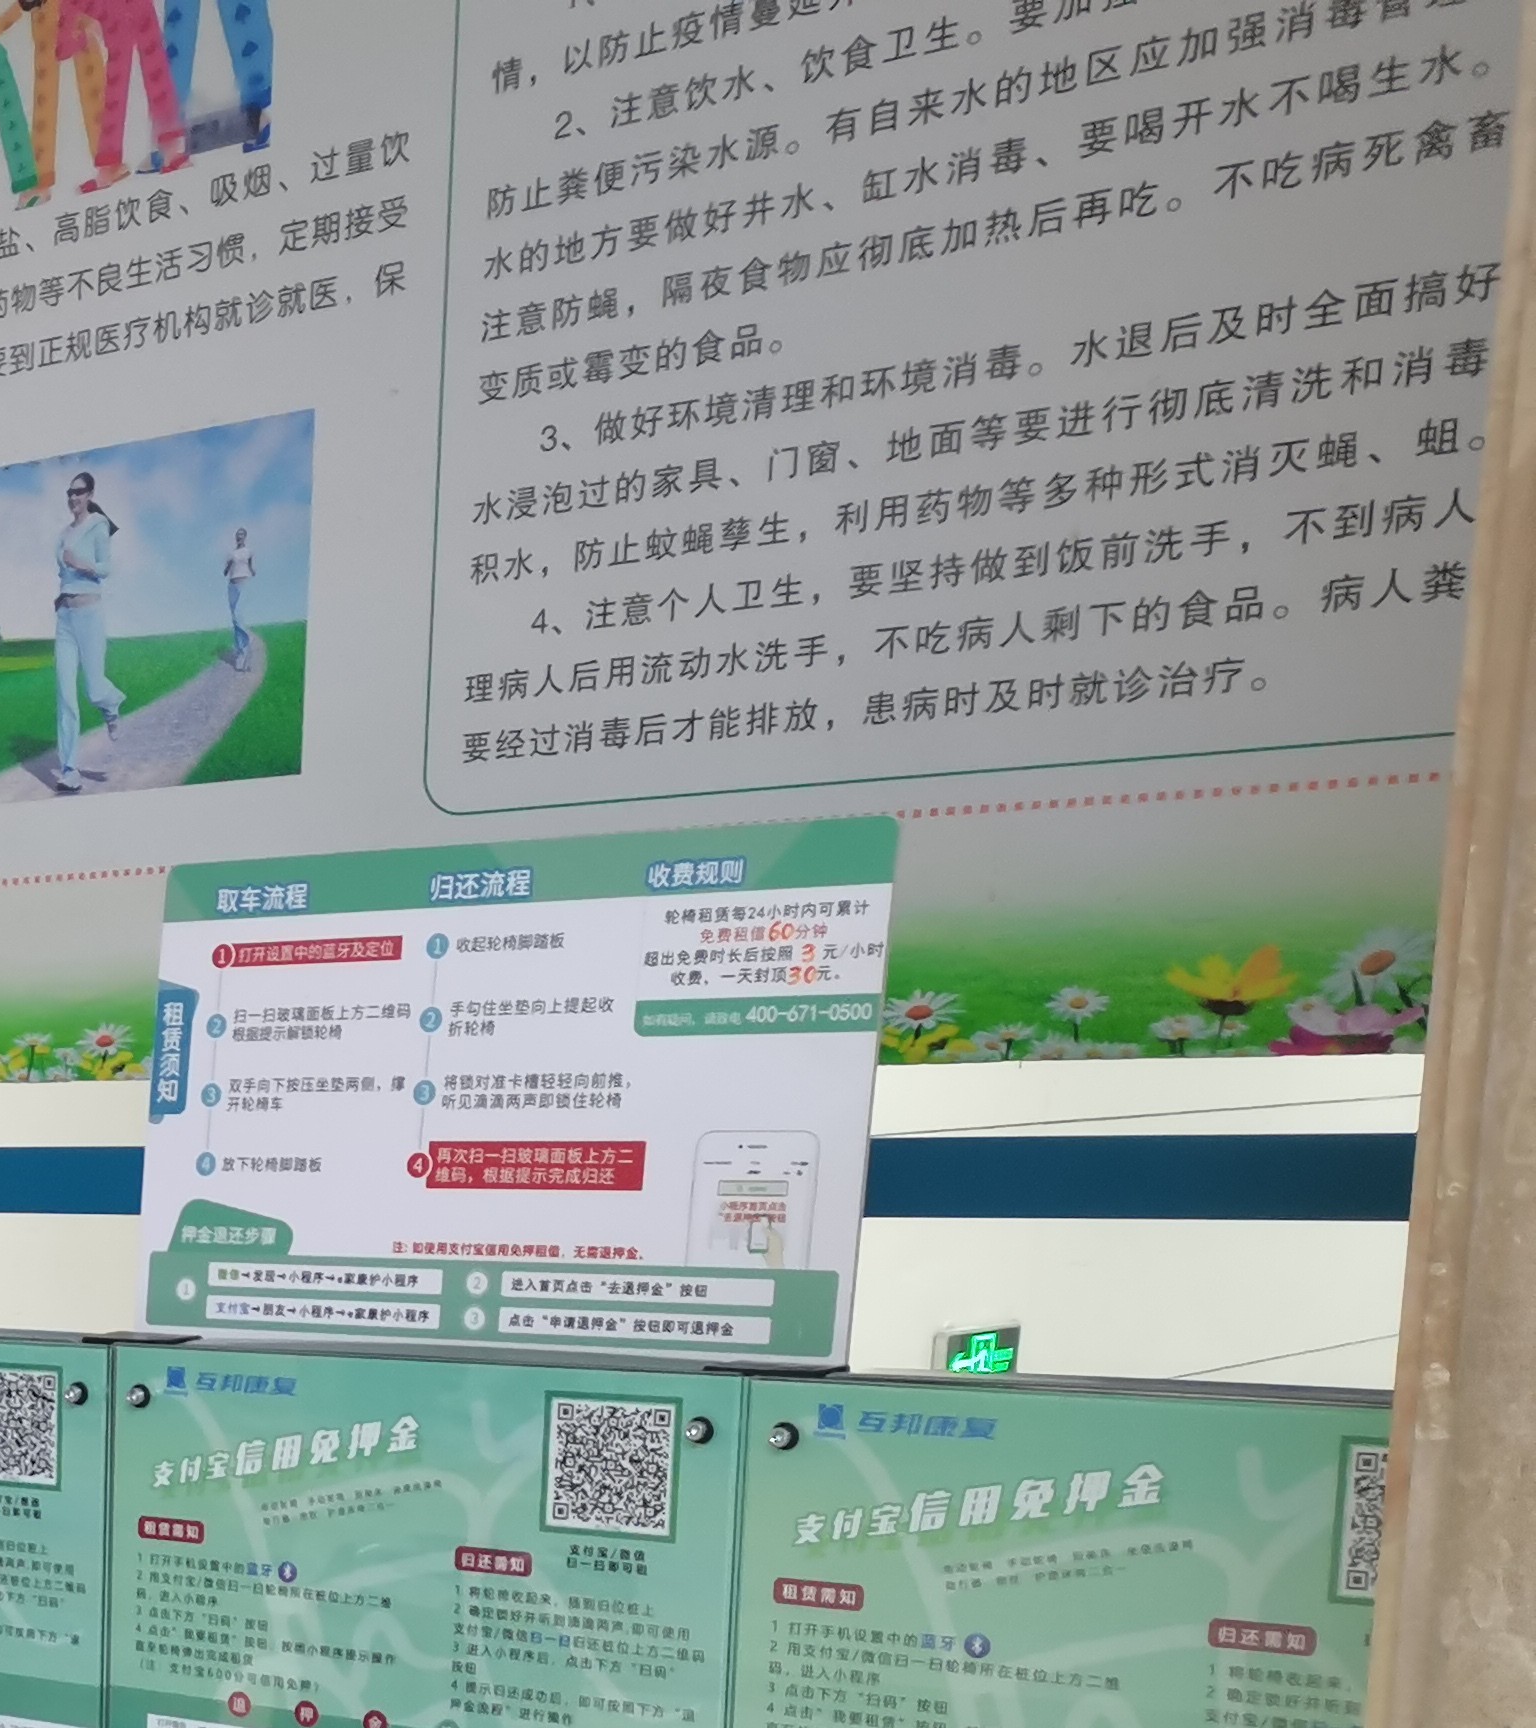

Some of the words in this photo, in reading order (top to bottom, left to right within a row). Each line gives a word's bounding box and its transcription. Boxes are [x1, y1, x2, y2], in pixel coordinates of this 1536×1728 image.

[478, 322, 782, 407] 变质或霉变的食品。
[216, 883, 309, 914] 取车流程
[430, 869, 532, 902] 归还流程
[648, 857, 745, 889] 收费规则
[238, 939, 395, 965] 打开设置中的蓝牙及定位
[456, 932, 566, 954] 收起轮椅脚踏板
[447, 1020, 496, 1038] 折轮椅
[744, 1003, 873, 1023] 400-671-0500
[156, 1003, 185, 1104] 租赁须知
[857, 1410, 999, 1441] 互邦康复
[152, 1414, 420, 1489] 支付宝信用免押金
[792, 1462, 1165, 1546] 支付宝信用免押金
